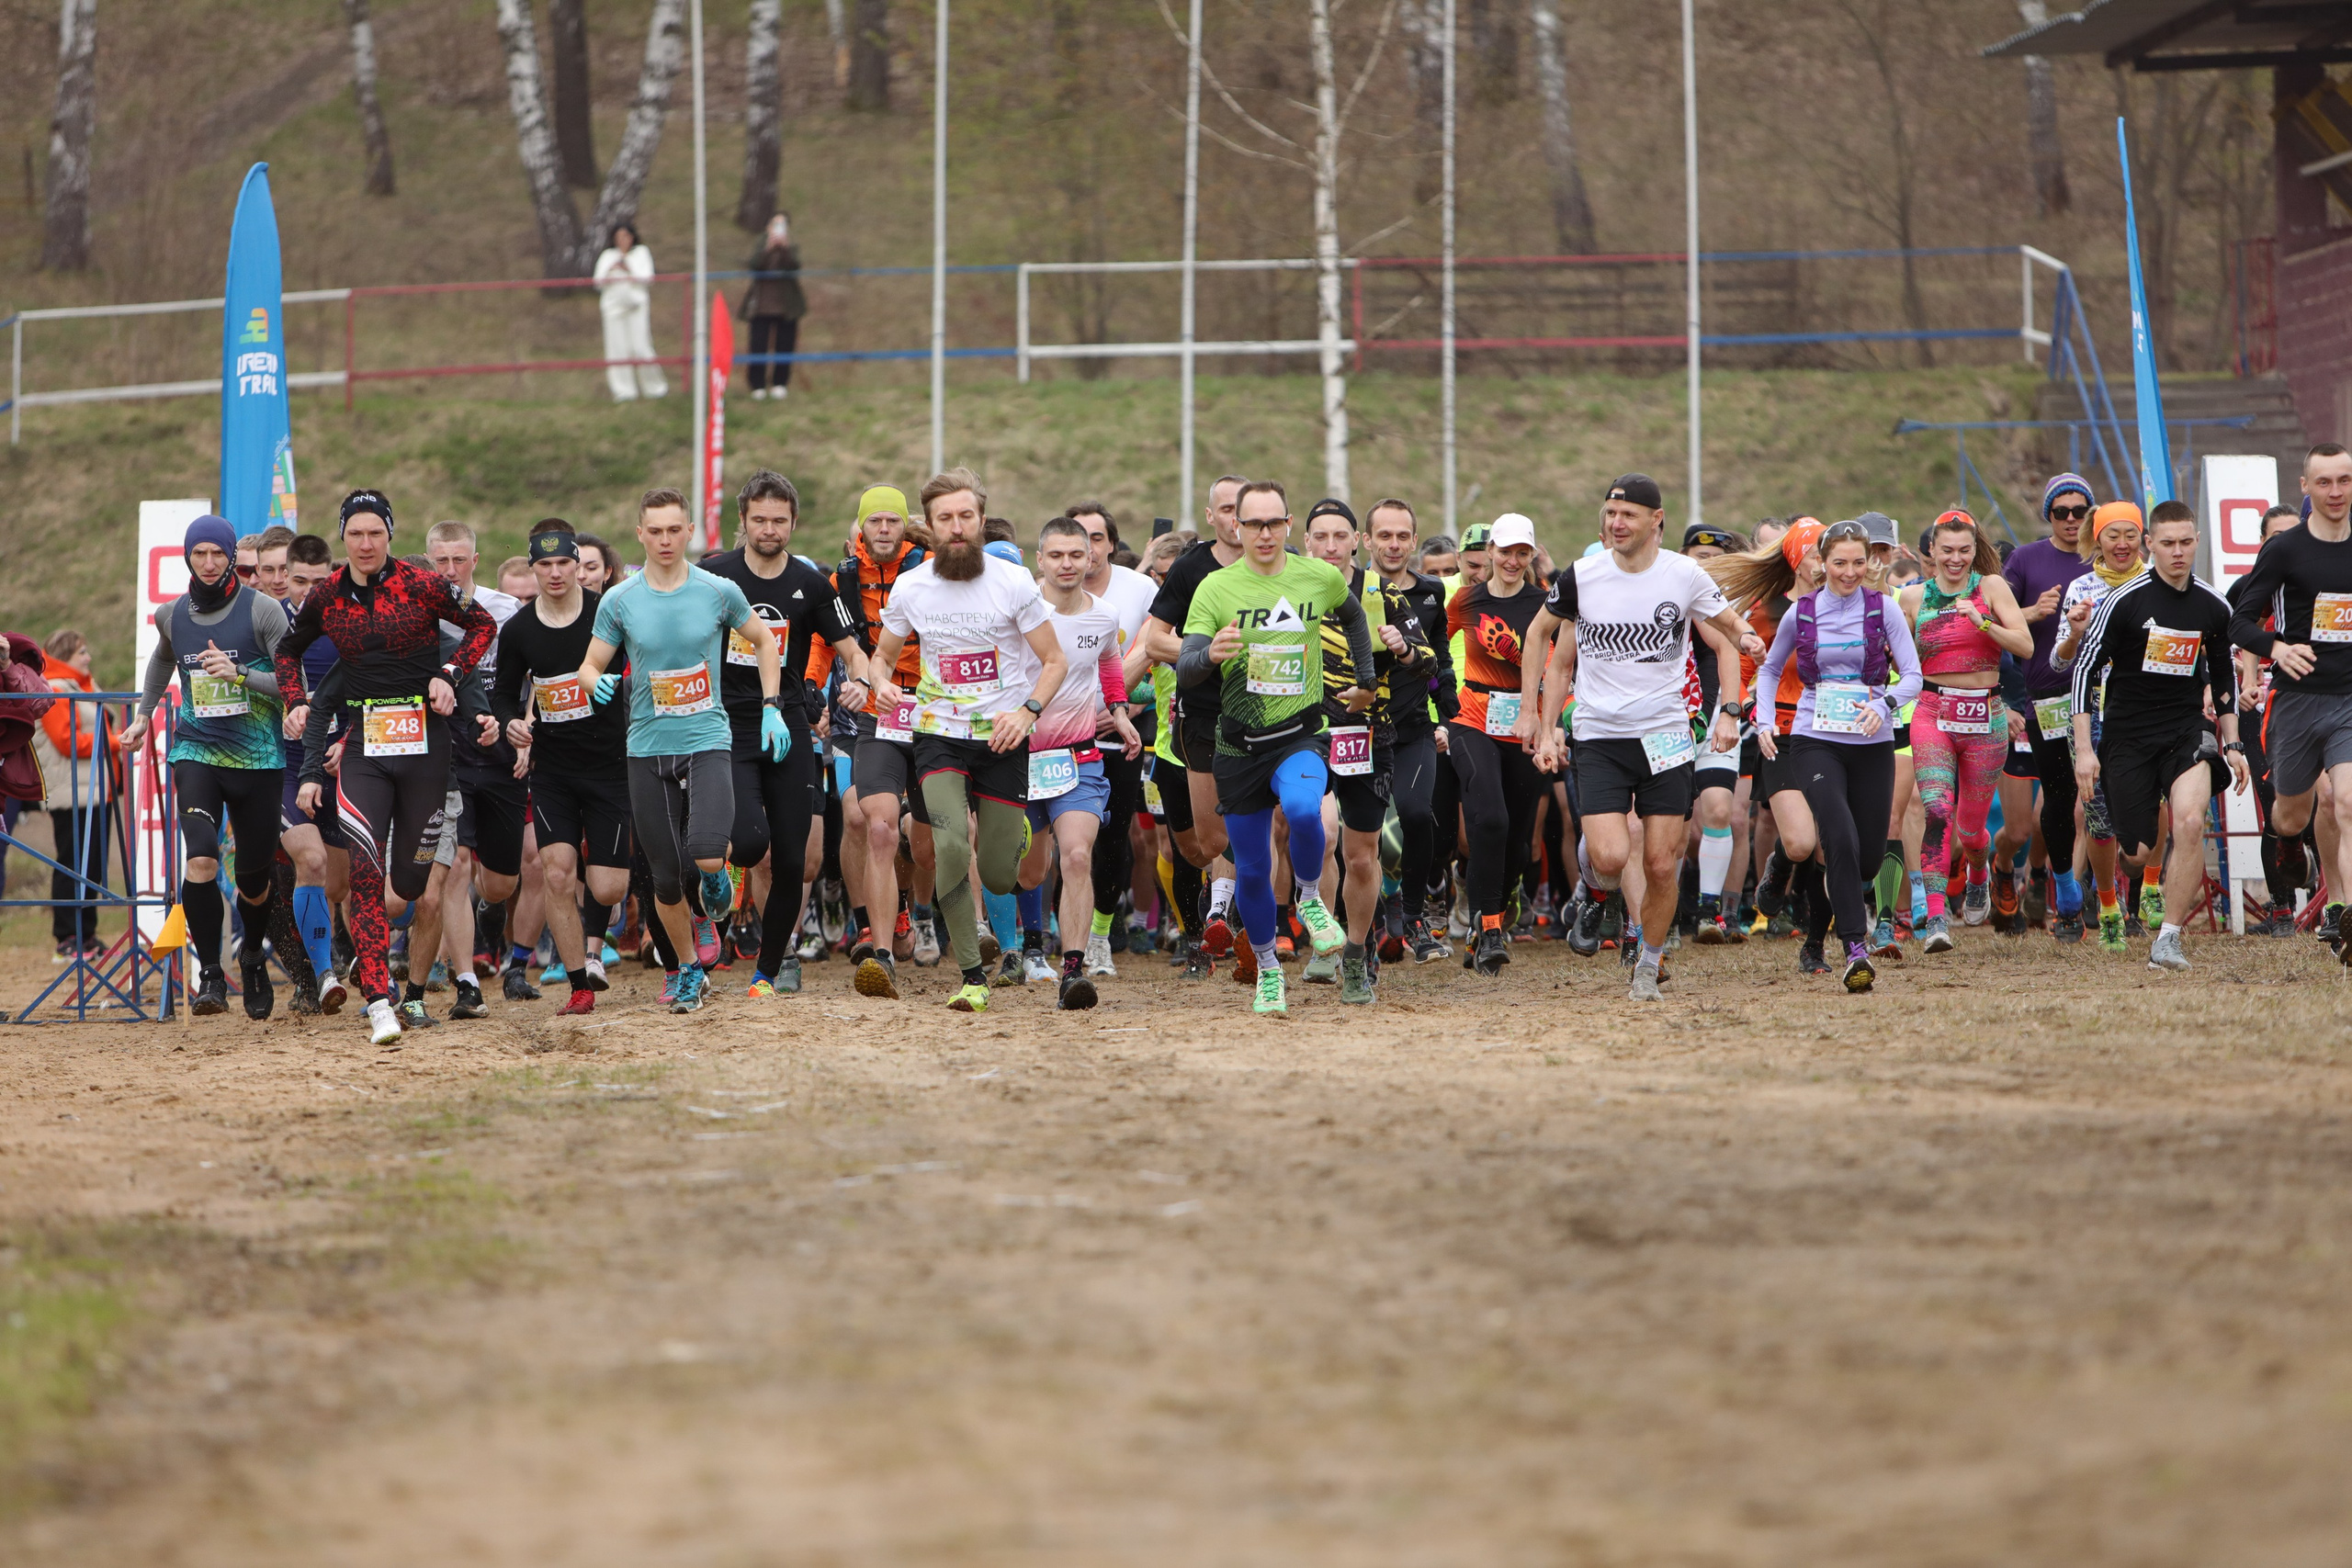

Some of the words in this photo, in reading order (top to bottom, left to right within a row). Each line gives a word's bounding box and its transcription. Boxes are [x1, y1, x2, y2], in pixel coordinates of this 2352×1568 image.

[924, 612, 996, 625] НАВСТРЕЧУ
[926, 626, 999, 640] ЗДОРОВЬЮ
[1594, 649, 1617, 660] BRIDE
[1615, 650, 1641, 662] ULTRA
[2165, 642, 2194, 659] 241
[959, 658, 995, 677] 812
[1269, 659, 1302, 676] 742
[209, 682, 243, 698] 714
[548, 684, 580, 705] 237
[673, 677, 707, 698] 240
[371, 696, 415, 705] POWERUP
[1956, 702, 1986, 716] 879
[385, 717, 420, 736] 248
[1336, 739, 1366, 757] 817
[1041, 761, 1073, 780] 406
